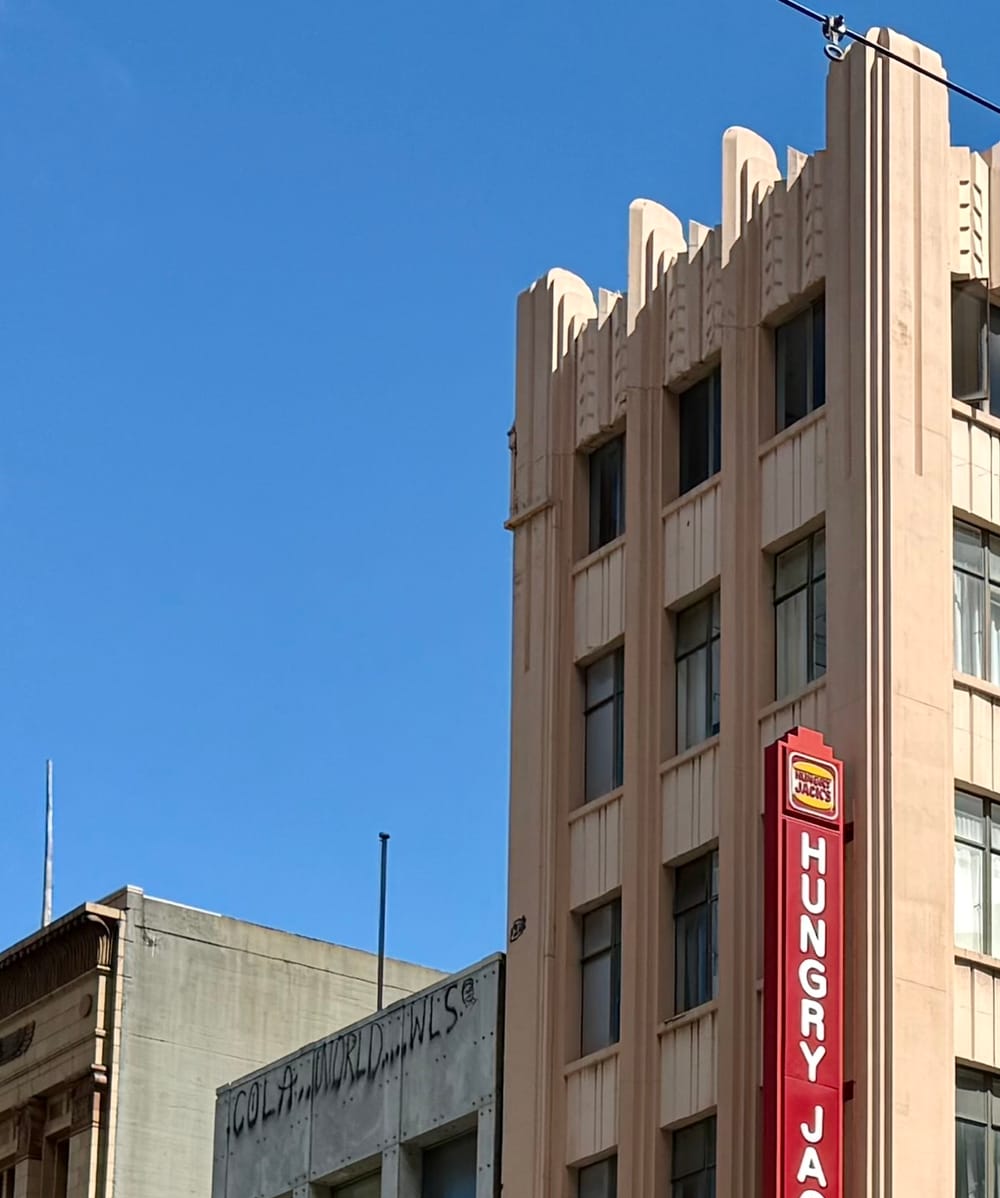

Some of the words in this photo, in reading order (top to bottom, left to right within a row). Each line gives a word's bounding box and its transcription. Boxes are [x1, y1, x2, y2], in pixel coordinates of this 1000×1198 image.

[794, 770, 832, 790] HUNGRY
[794, 781, 832, 802] JACK'S
[798, 830, 828, 1082] HUNGRY
